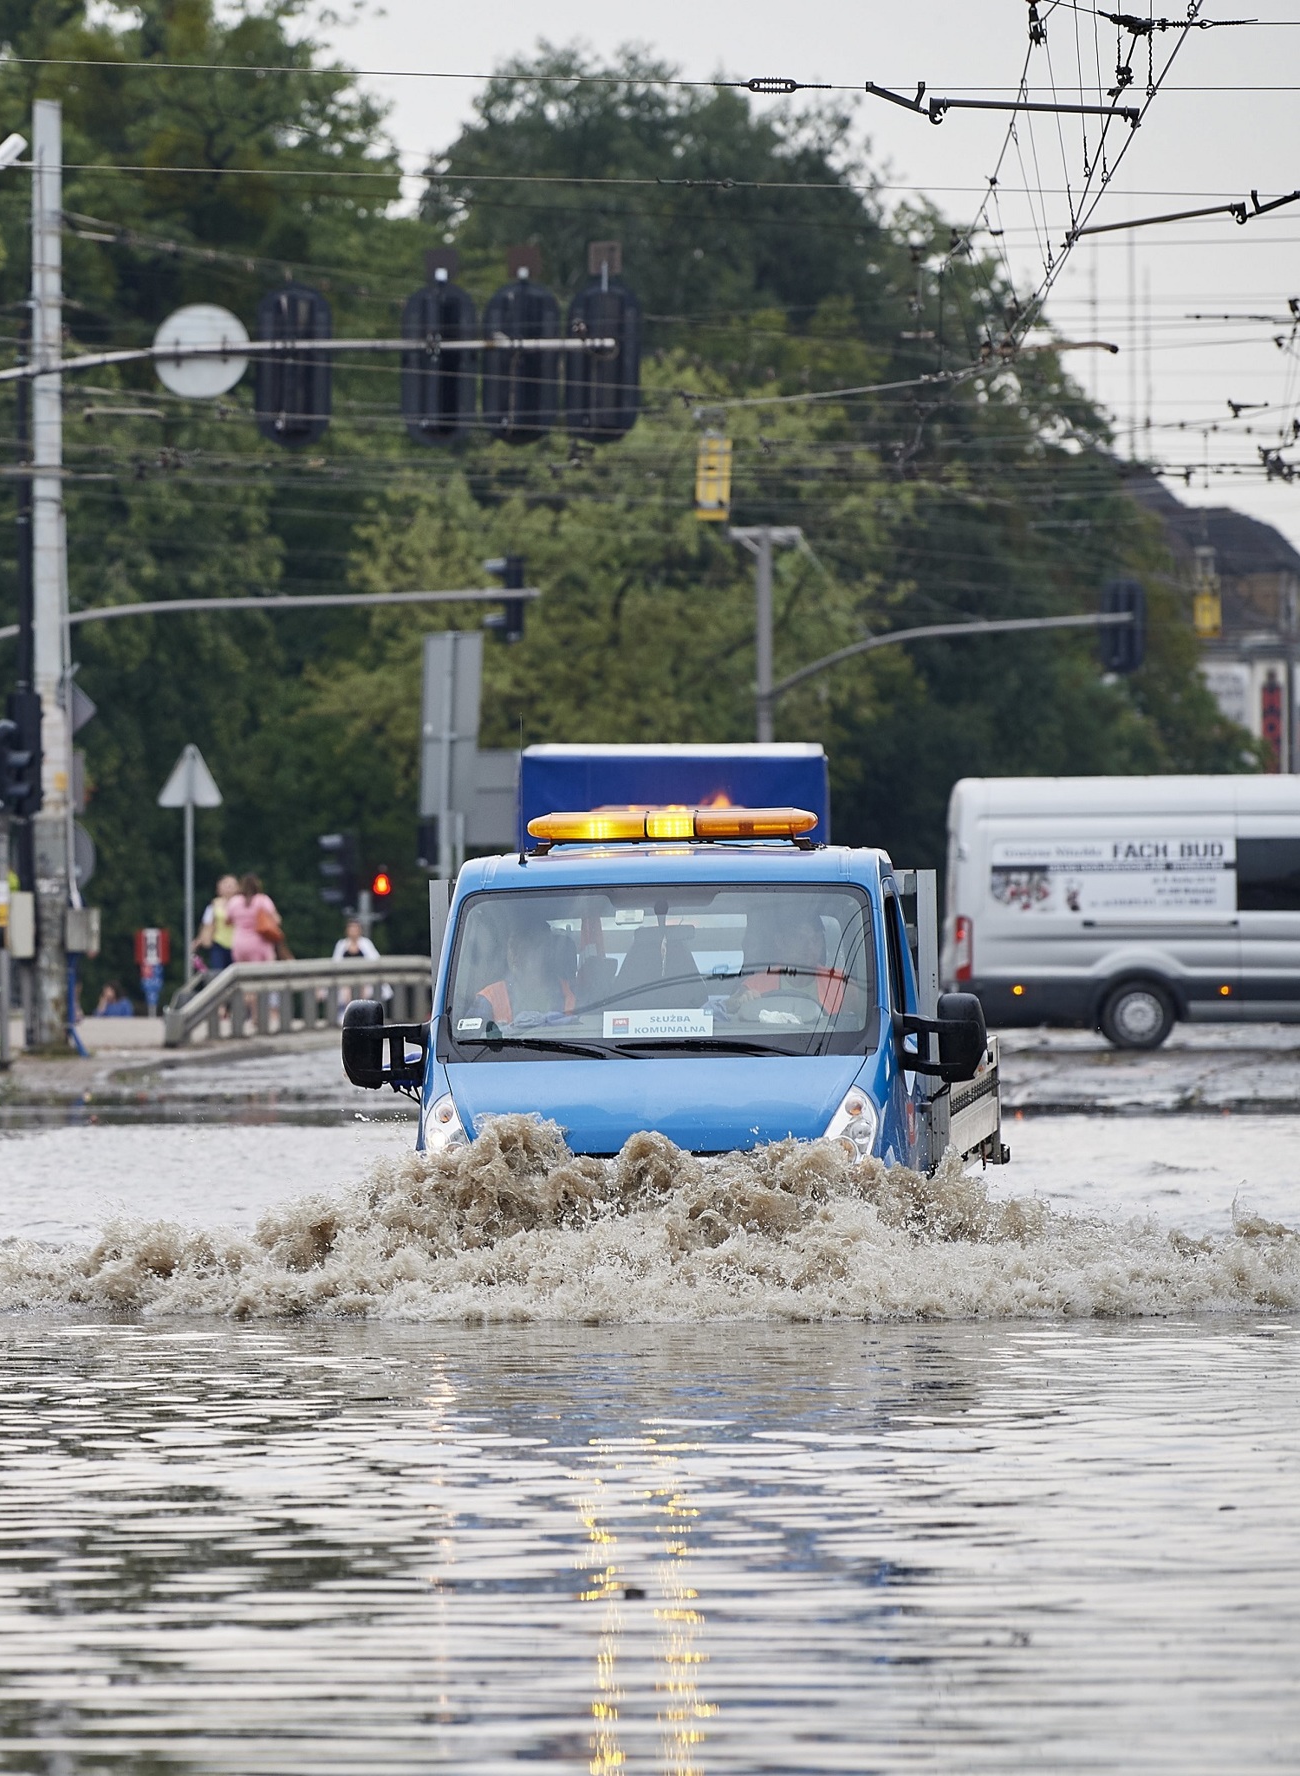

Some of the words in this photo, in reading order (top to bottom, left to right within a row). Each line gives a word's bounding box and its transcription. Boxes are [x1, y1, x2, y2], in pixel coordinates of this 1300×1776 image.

[1112, 842, 1168, 858] FACH
[1179, 842, 1224, 857] BUD
[649, 1014, 691, 1023] SŁUŻBA
[634, 1026, 706, 1034] KOMUNALNA
